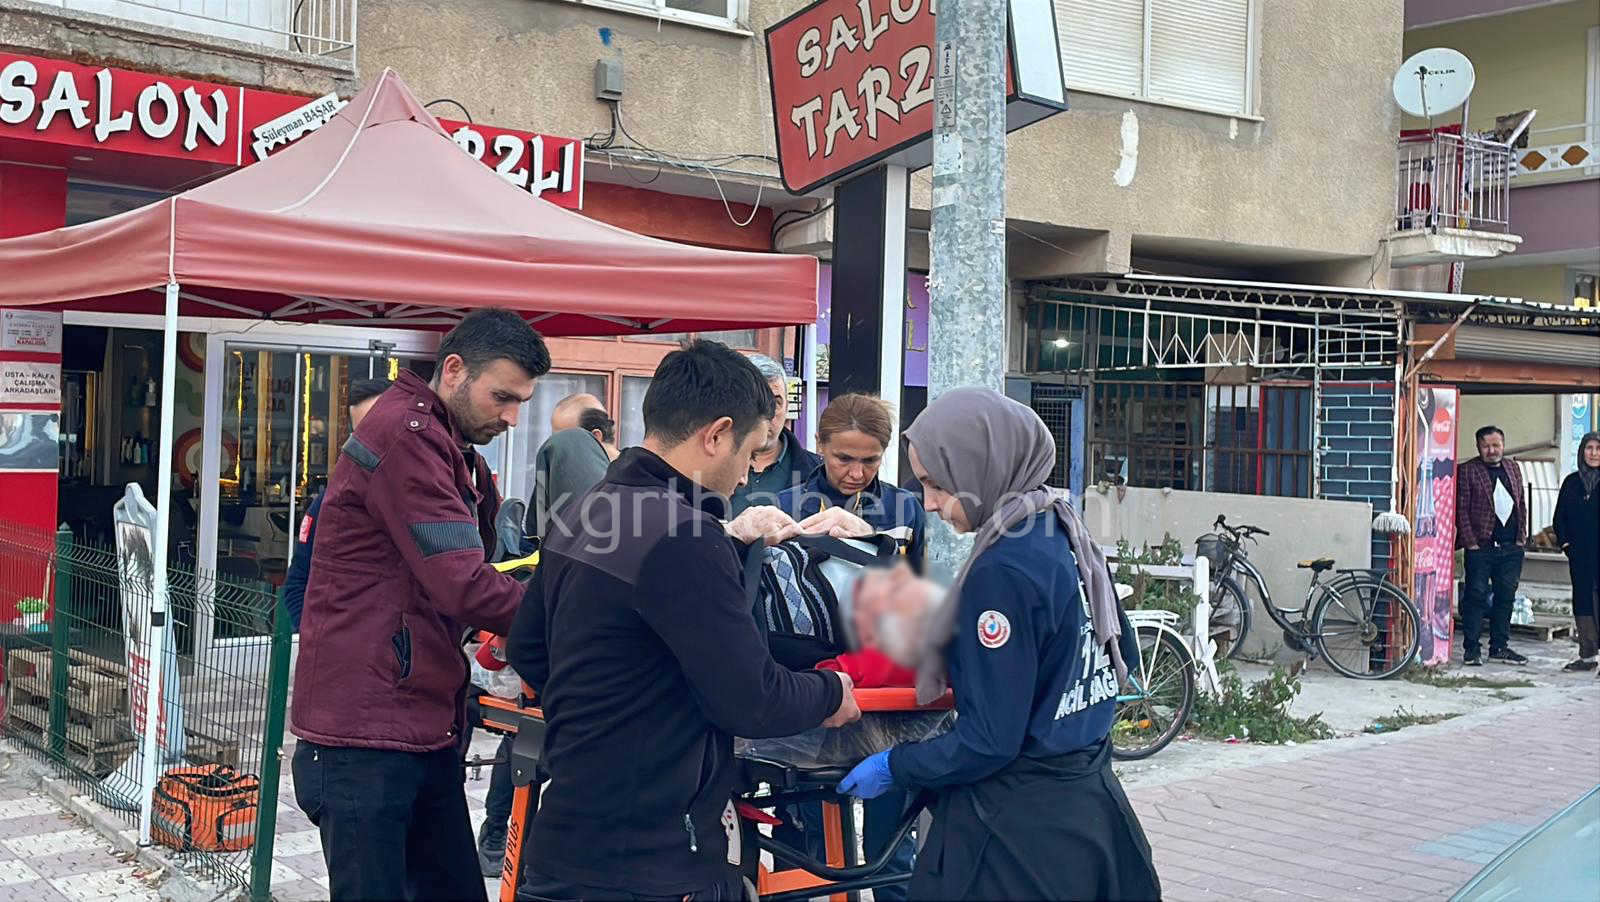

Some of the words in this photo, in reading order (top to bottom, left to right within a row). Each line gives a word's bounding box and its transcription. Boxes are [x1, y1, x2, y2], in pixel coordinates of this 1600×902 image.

[0, 60, 229, 151] SALON
[261, 118, 304, 143] Süleyman
[303, 100, 336, 123] BAŞAR
[32, 371, 56, 380] KALFA
[4, 387, 56, 395] ARKADAŞLARI
